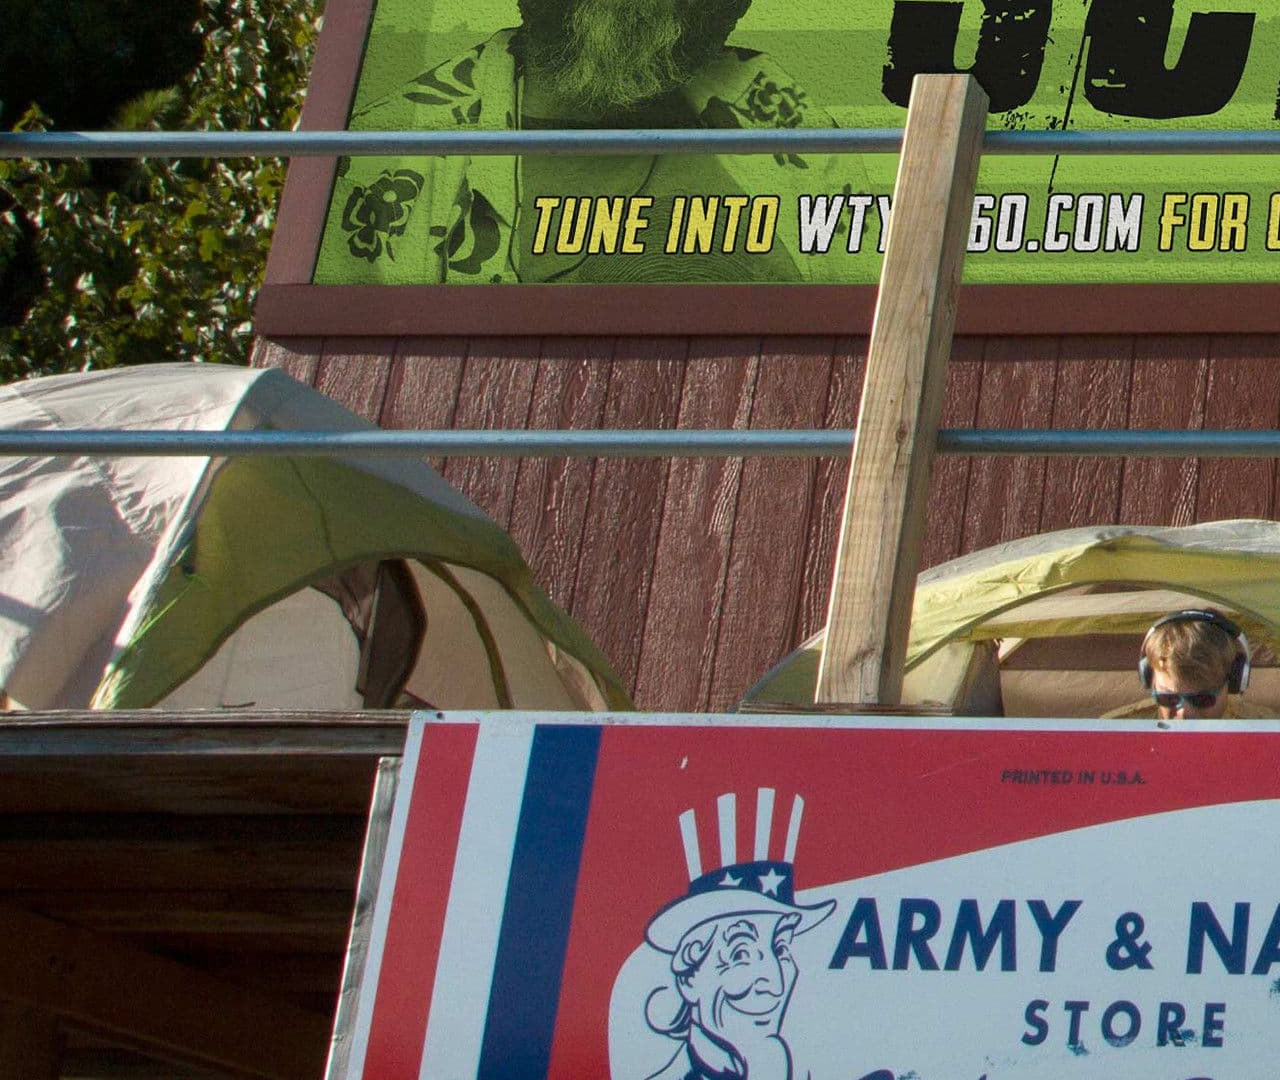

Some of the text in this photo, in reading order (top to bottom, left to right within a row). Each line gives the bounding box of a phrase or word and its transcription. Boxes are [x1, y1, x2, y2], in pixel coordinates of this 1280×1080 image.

[532, 194, 654, 255] TUNE
[664, 194, 780, 255] INTO
[798, 193, 1145, 254] WTY60.COM
[1158, 192, 1249, 252] FOR
[1000, 769, 1073, 785] PRINTED
[1078, 770, 1095, 785] IN
[828, 896, 1083, 973] ARMY
[1105, 911, 1154, 972] &
[1020, 999, 1227, 1050] STORE
